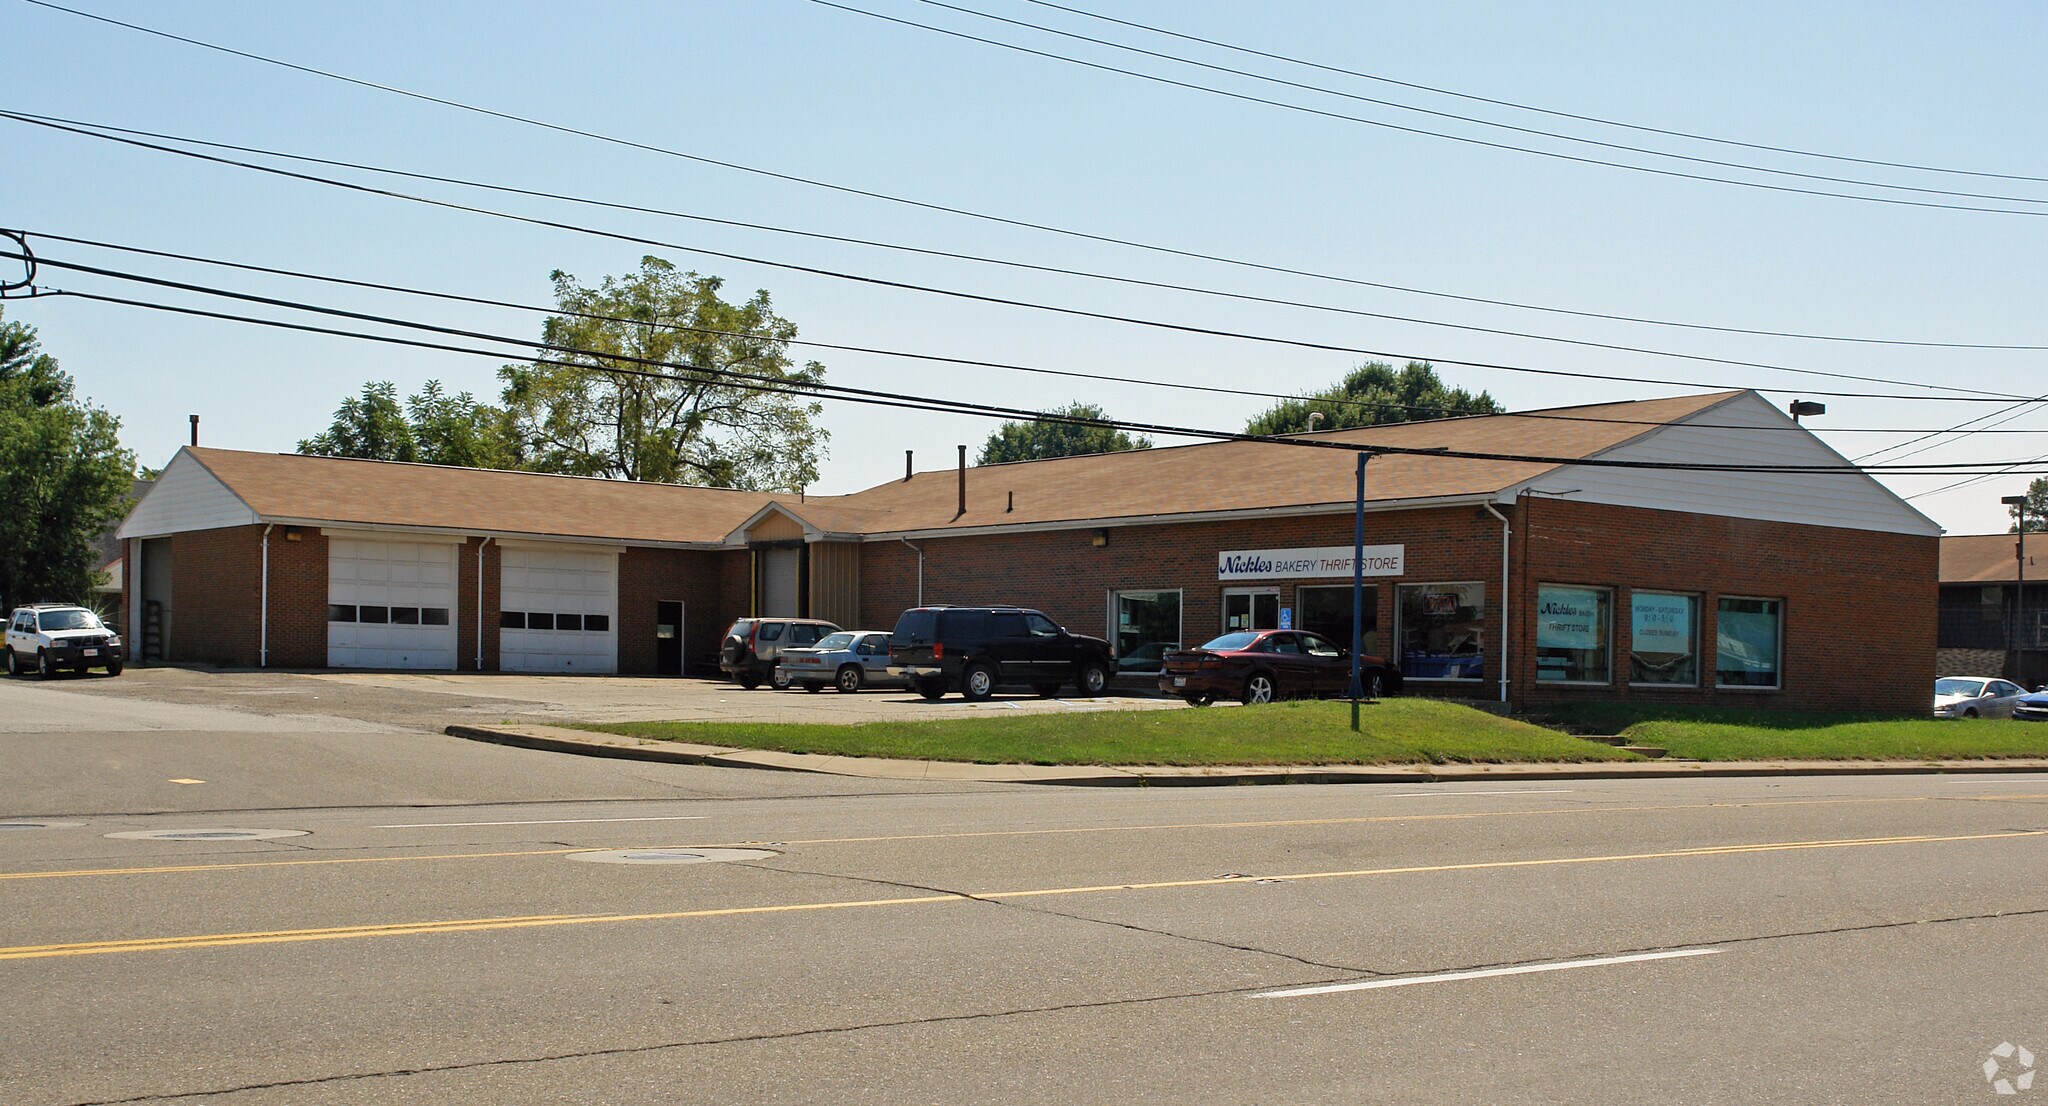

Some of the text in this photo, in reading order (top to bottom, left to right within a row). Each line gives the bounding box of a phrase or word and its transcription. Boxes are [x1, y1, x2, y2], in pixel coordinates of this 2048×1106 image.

[1219, 555, 1398, 574] Nickles BAKERY THRIFT STORE
[1540, 602, 1577, 616] Nickles
[1548, 623, 1590, 633] THRIFT STORE
